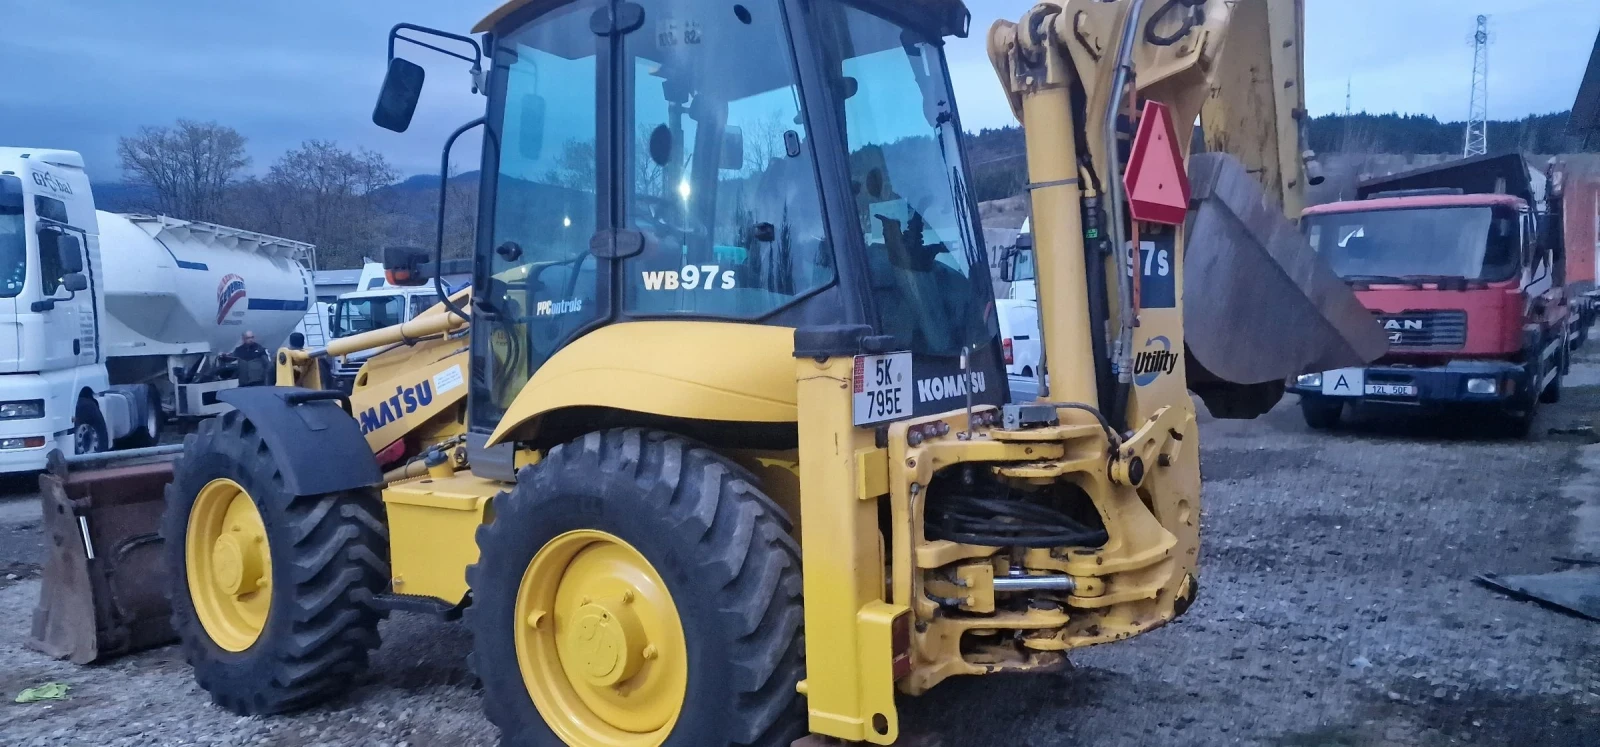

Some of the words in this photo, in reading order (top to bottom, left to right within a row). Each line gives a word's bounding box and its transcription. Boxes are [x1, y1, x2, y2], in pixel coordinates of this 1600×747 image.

[536, 298, 582, 316] PPControls
[1377, 319, 1422, 329] AN
[876, 358, 892, 386] 5K
[1134, 350, 1178, 375] Utility
[1334, 374, 1350, 391] A
[867, 387, 902, 419] 795E
